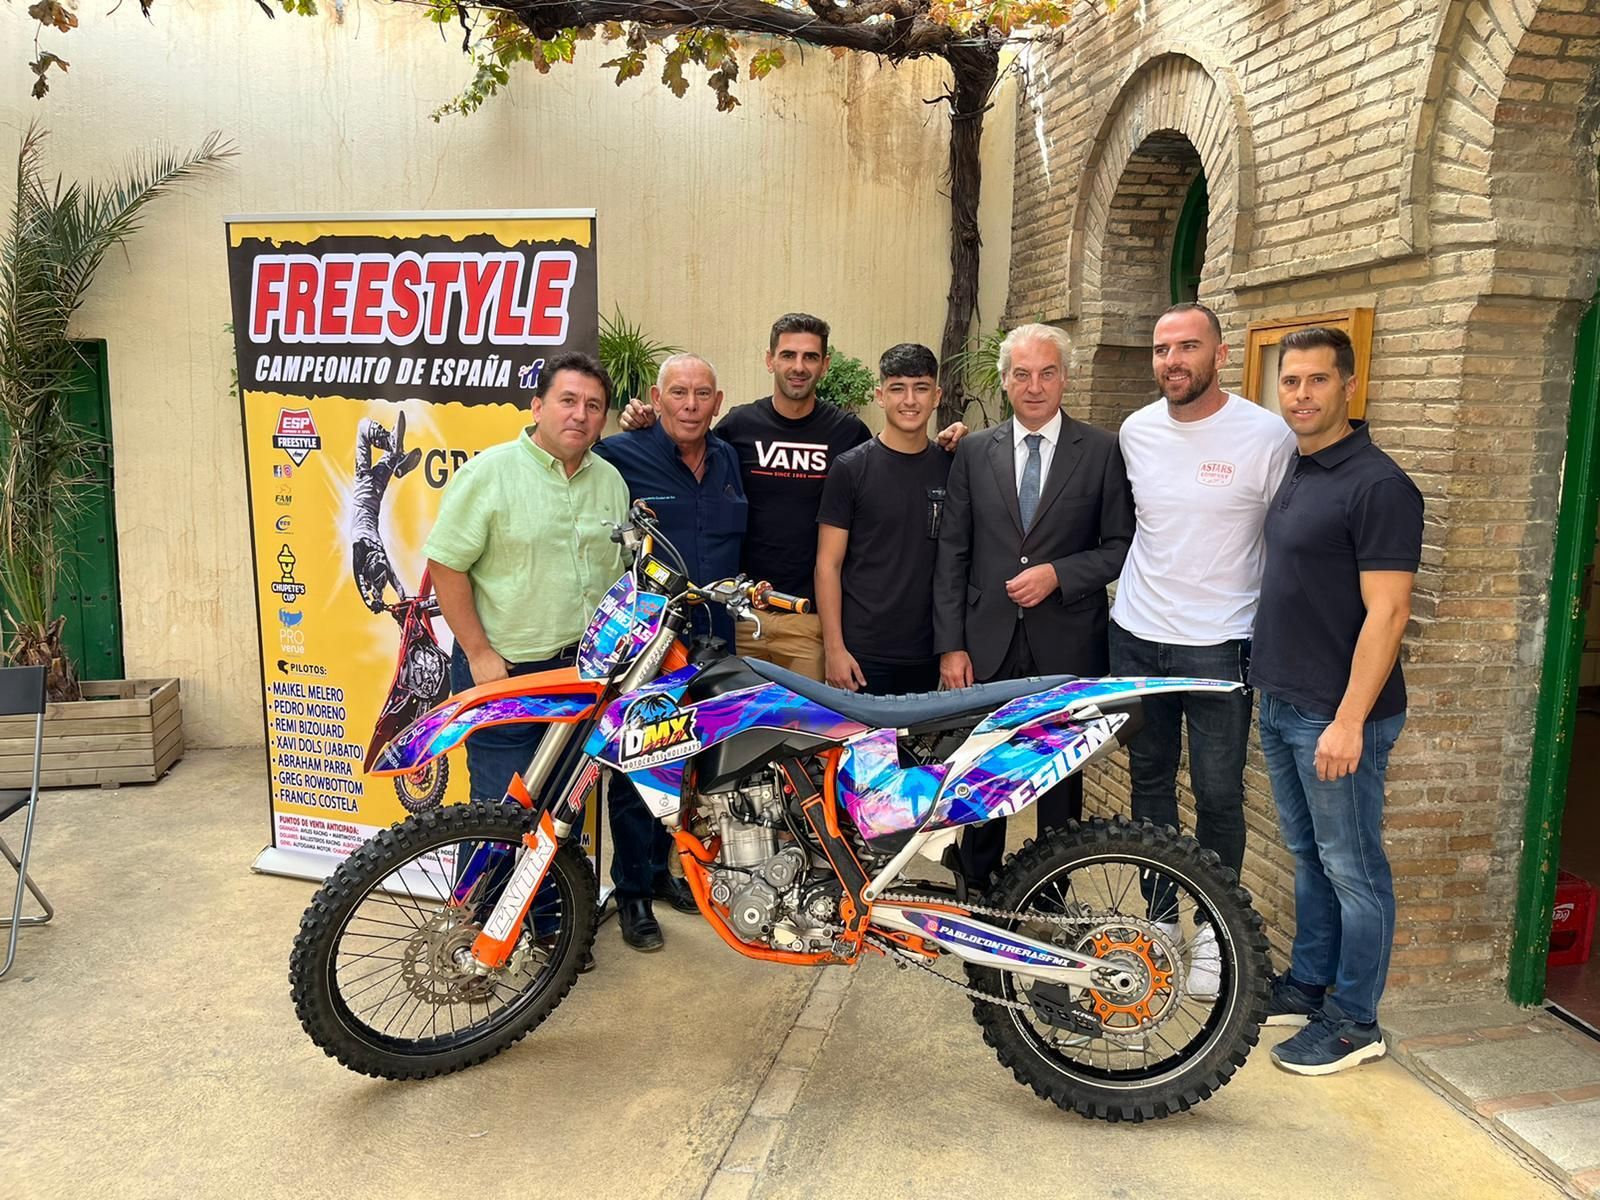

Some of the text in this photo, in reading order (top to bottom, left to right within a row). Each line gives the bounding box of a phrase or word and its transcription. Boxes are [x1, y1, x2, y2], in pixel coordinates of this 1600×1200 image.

[250, 253, 576, 344] FREESTYLE
[255, 354, 512, 388] CAMPEONATO DE ESPAÑA
[282, 417, 310, 429] ESP
[277, 437, 317, 448] FREESTYLE
[755, 440, 829, 472] VANS
[1200, 463, 1233, 474] ASTARS
[275, 495, 292, 503] FAM
[272, 583, 305, 594] CHUPETE'S
[283, 593, 296, 602] CUP
[280, 629, 304, 645] PRO
[281, 644, 304, 654] venue
[290, 663, 327, 676] PILOTOS:
[273, 681, 344, 702] MAIKEL MELERO
[274, 699, 346, 721] PEDRO MORENO
[275, 717, 344, 739] REMI BIZOUARD
[625, 715, 689, 757] DMX
[276, 735, 297, 750] XAVI
[298, 738, 322, 754] DOLS
[324, 741, 364, 761] (JABATO)
[623, 743, 700, 769] MOTOCROSS HOLIDAYS
[278, 753, 352, 776] ABRAHAM PARRA
[988, 712, 1130, 817] DESIGNS
[278, 771, 363, 795] GREG ROWBOTTOM
[280, 788, 358, 812] FRANCIS COSTELA
[279, 815, 359, 835] PUNTOS DE VENTA ANTICIPADA:
[938, 925, 1071, 967] PABLOCONTRERASFMX
